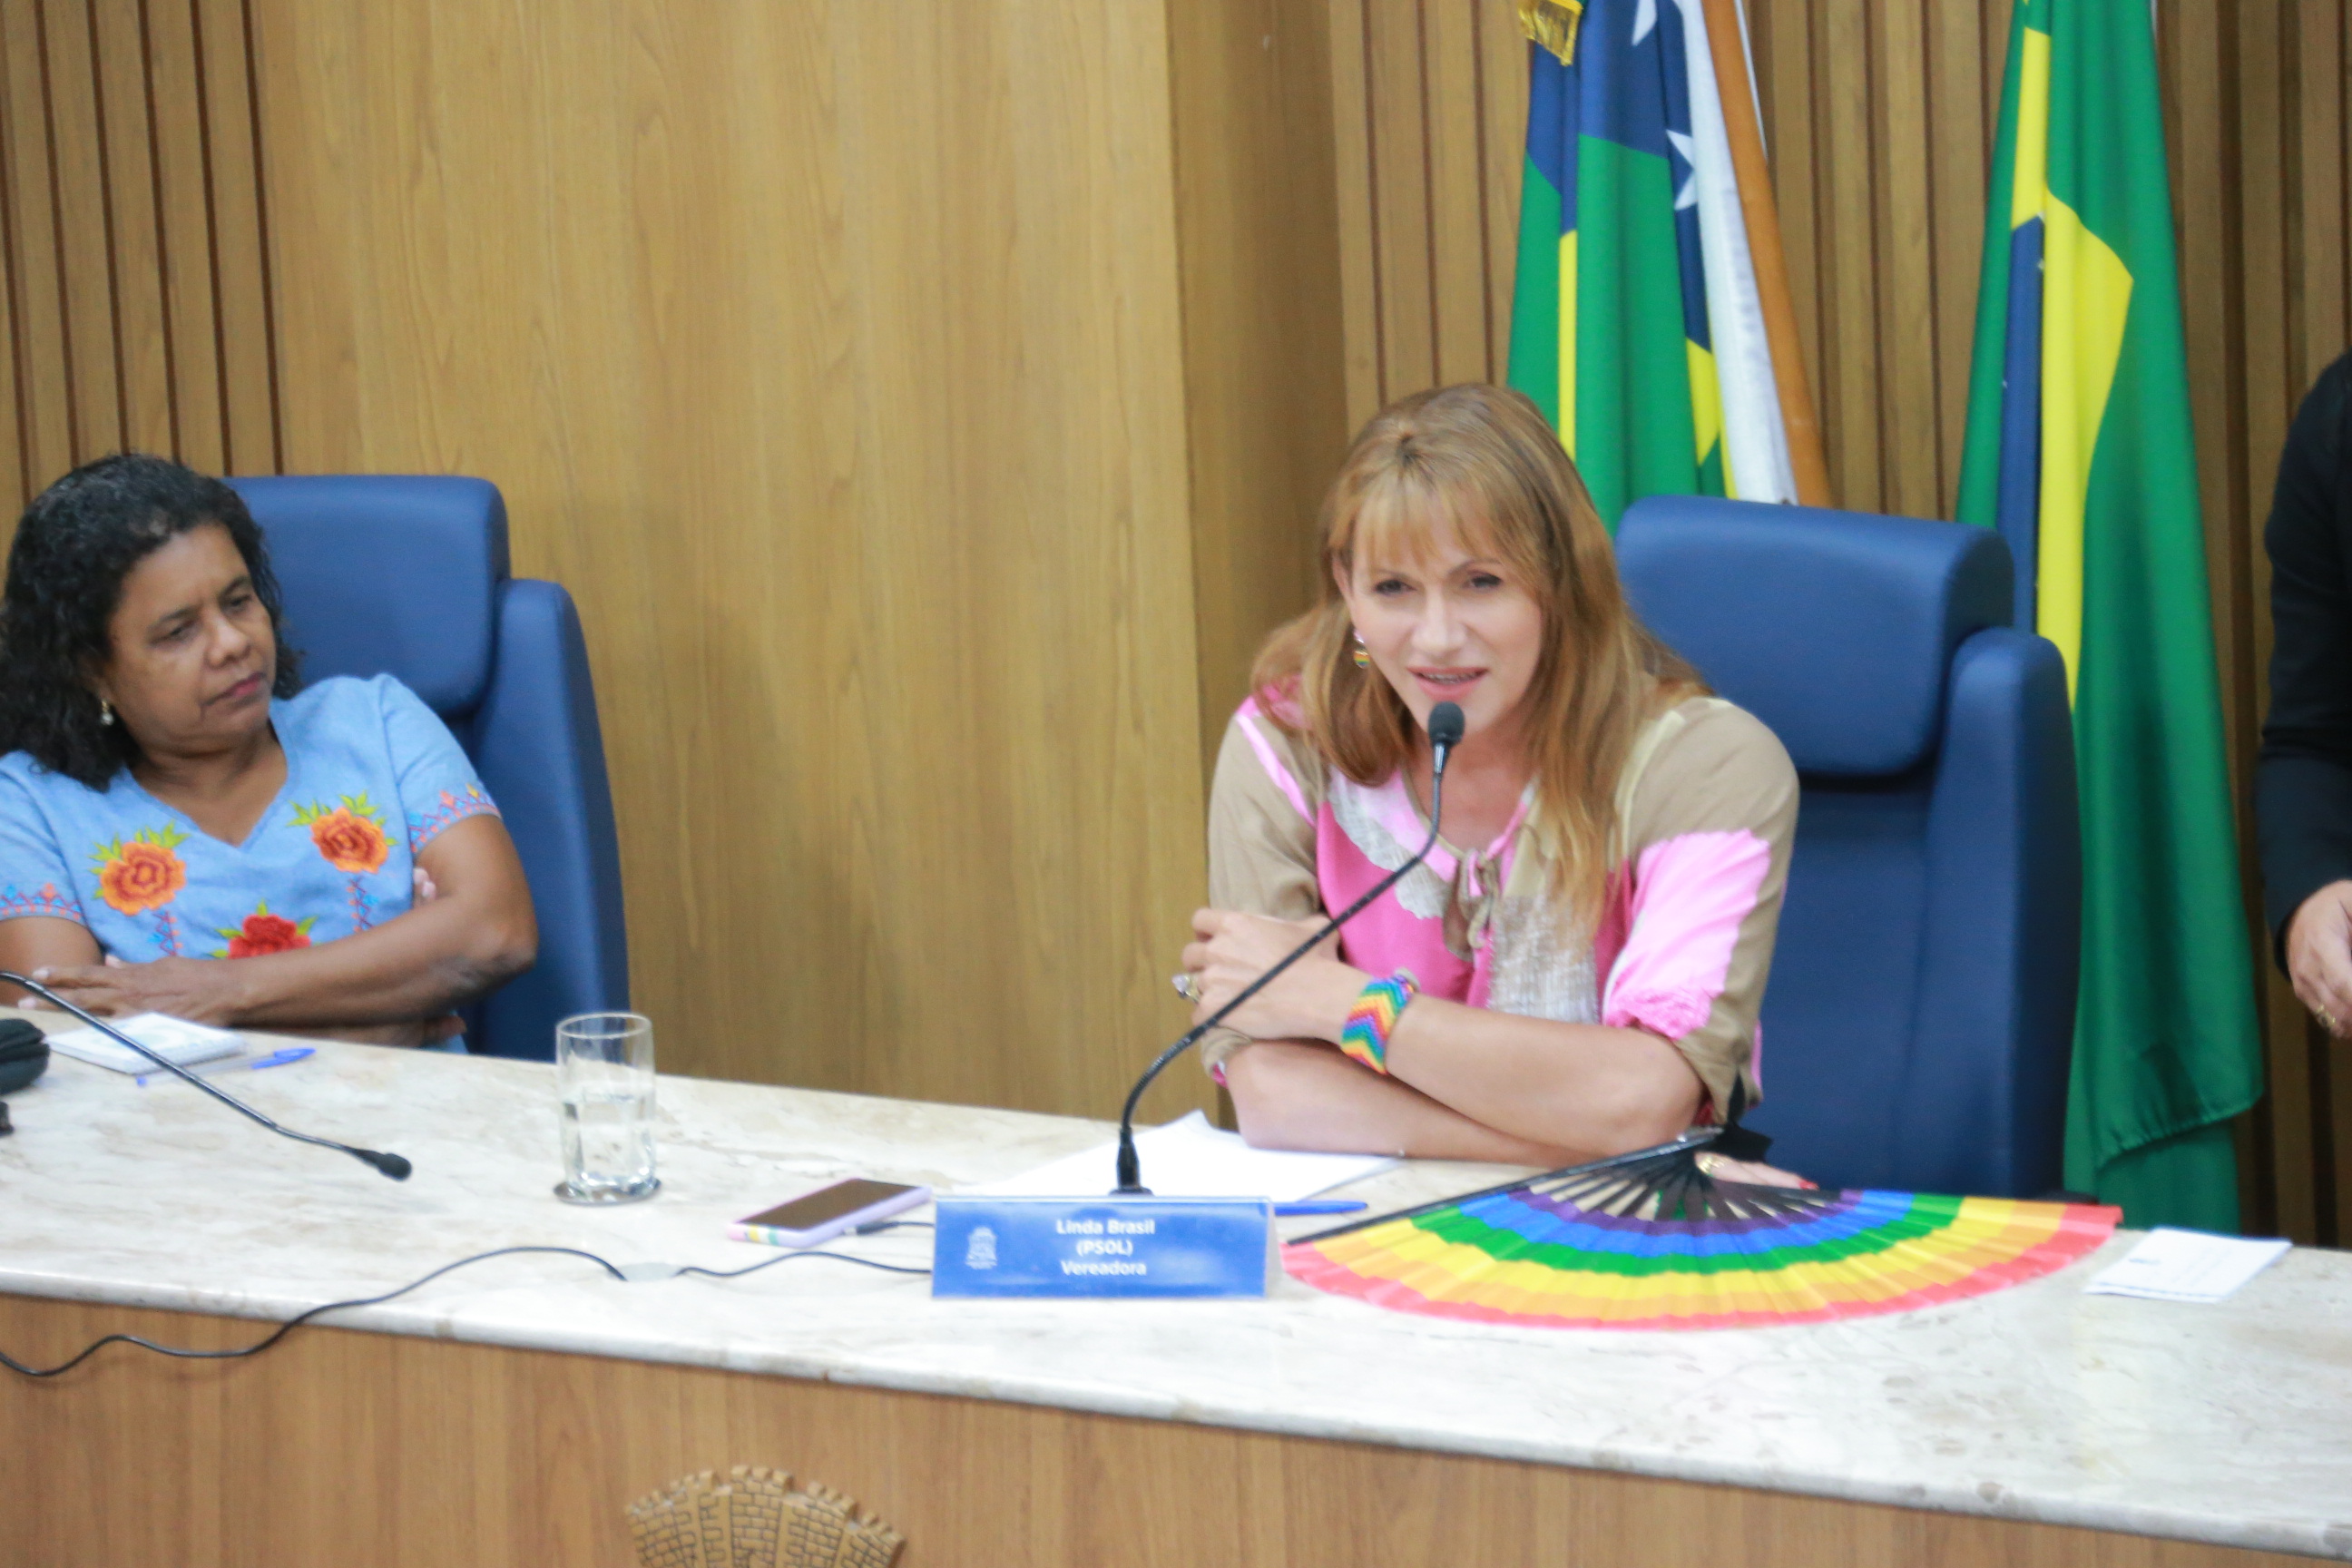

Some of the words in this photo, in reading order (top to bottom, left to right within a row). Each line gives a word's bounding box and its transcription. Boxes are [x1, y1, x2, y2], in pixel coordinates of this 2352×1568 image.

[1056, 1219, 1103, 1236] Linda
[1108, 1219, 1155, 1236] Brasil
[1076, 1240, 1133, 1257] (PSOL)
[1061, 1260, 1146, 1276] Vereadora
